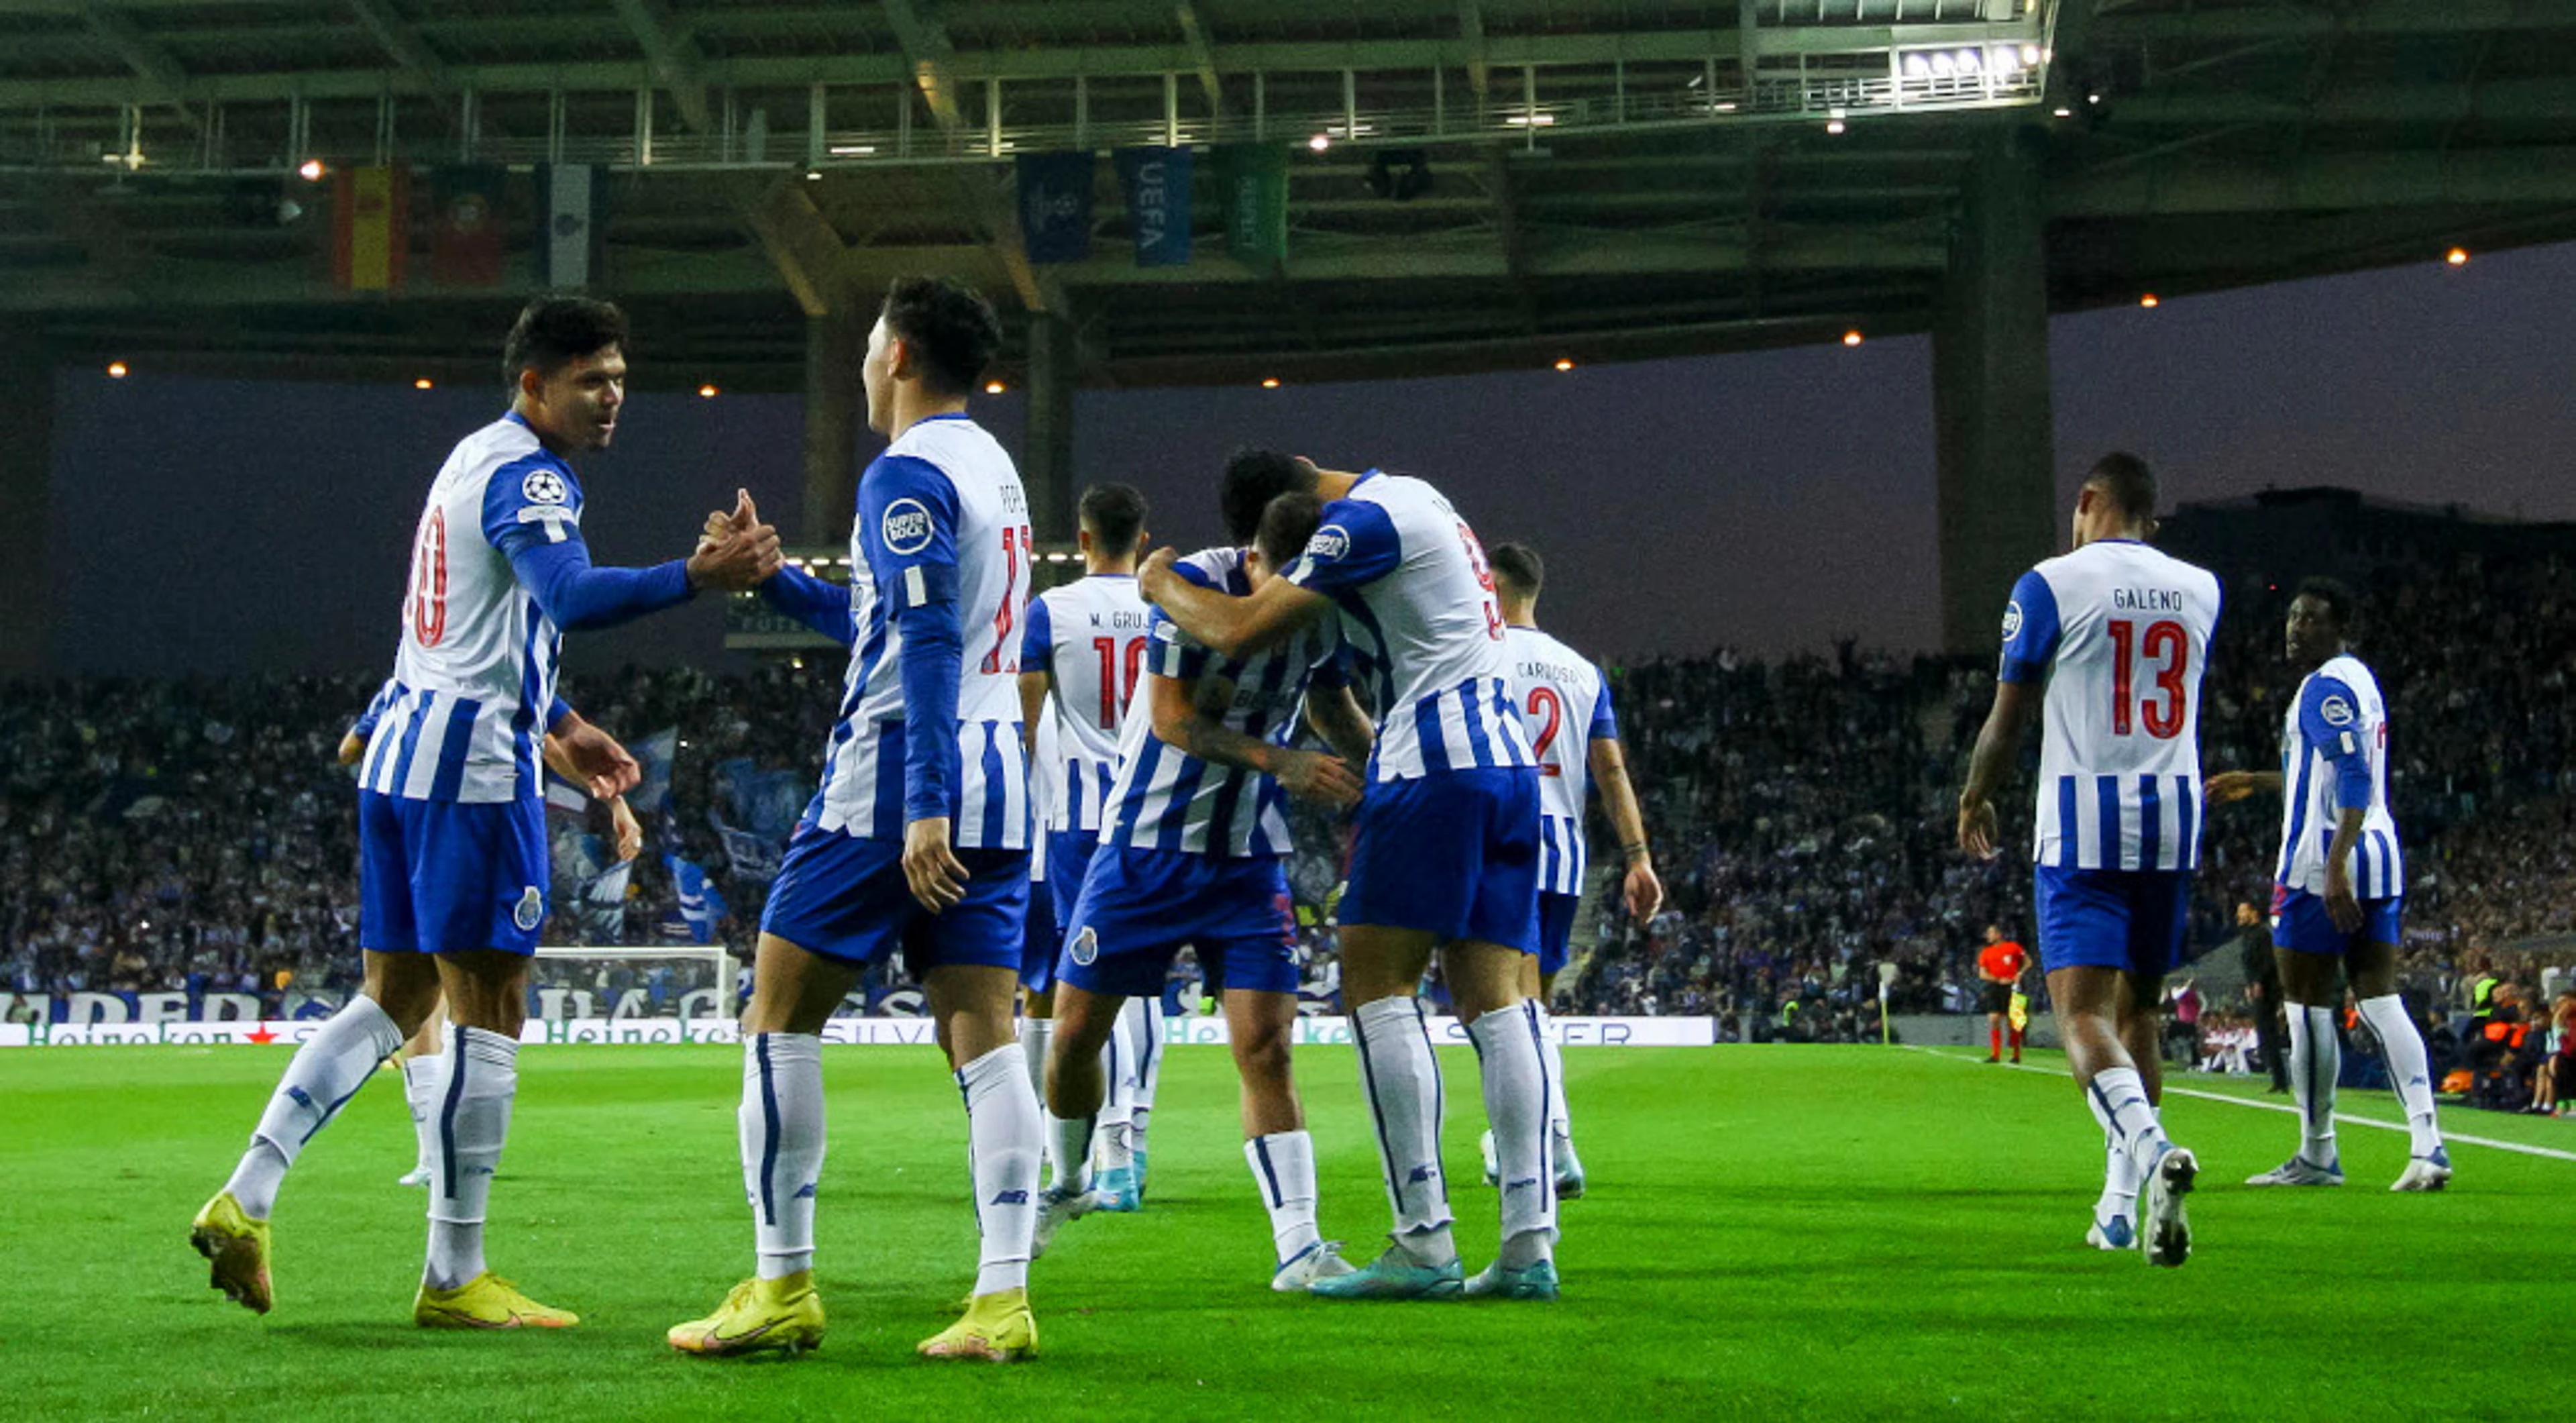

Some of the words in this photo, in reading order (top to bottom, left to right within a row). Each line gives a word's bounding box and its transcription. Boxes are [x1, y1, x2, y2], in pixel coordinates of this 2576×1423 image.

[1138, 162, 1167, 250] UEFA
[2114, 588, 2182, 611] GALENO
[1517, 662, 1578, 684] CARDOSO
[2108, 620, 2188, 739] 13
[1528, 686, 1561, 776] 2
[28, 1021, 232, 1045] Heineken
